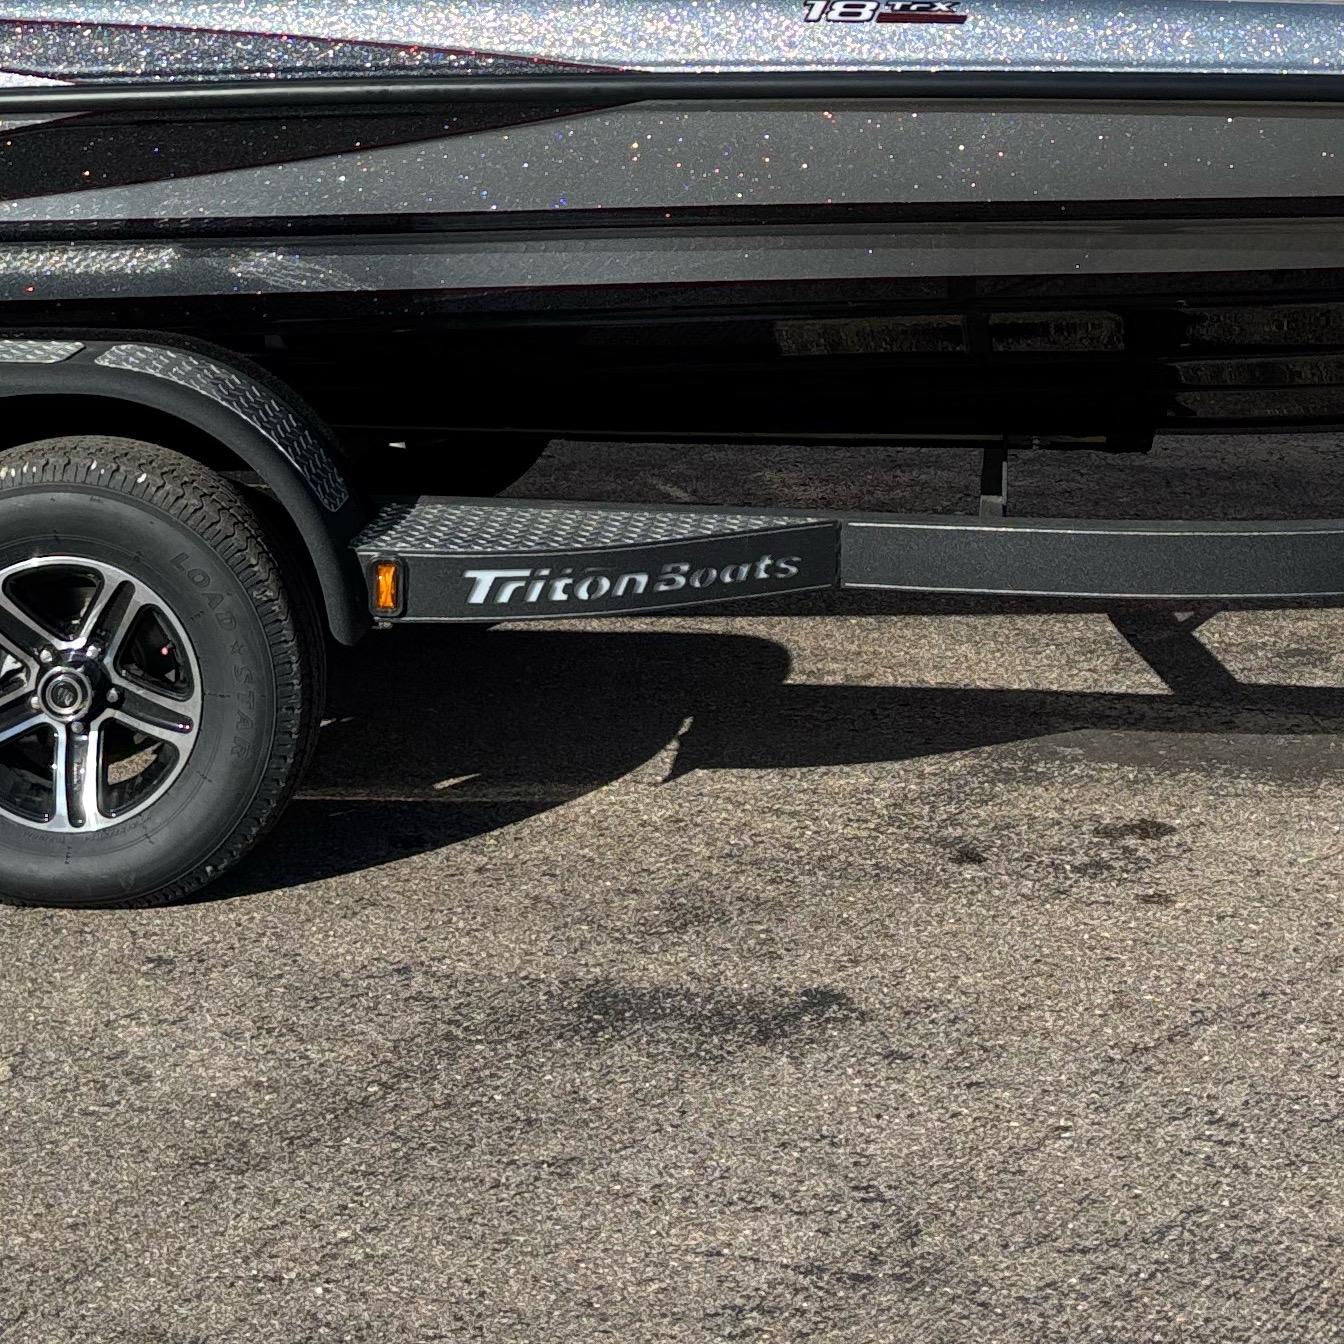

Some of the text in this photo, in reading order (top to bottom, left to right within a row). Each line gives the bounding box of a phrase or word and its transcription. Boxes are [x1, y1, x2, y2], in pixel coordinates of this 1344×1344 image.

[803, 0, 881, 23] 18
[463, 566, 649, 605] Triton
[172, 551, 256, 760] LOAD STAR
